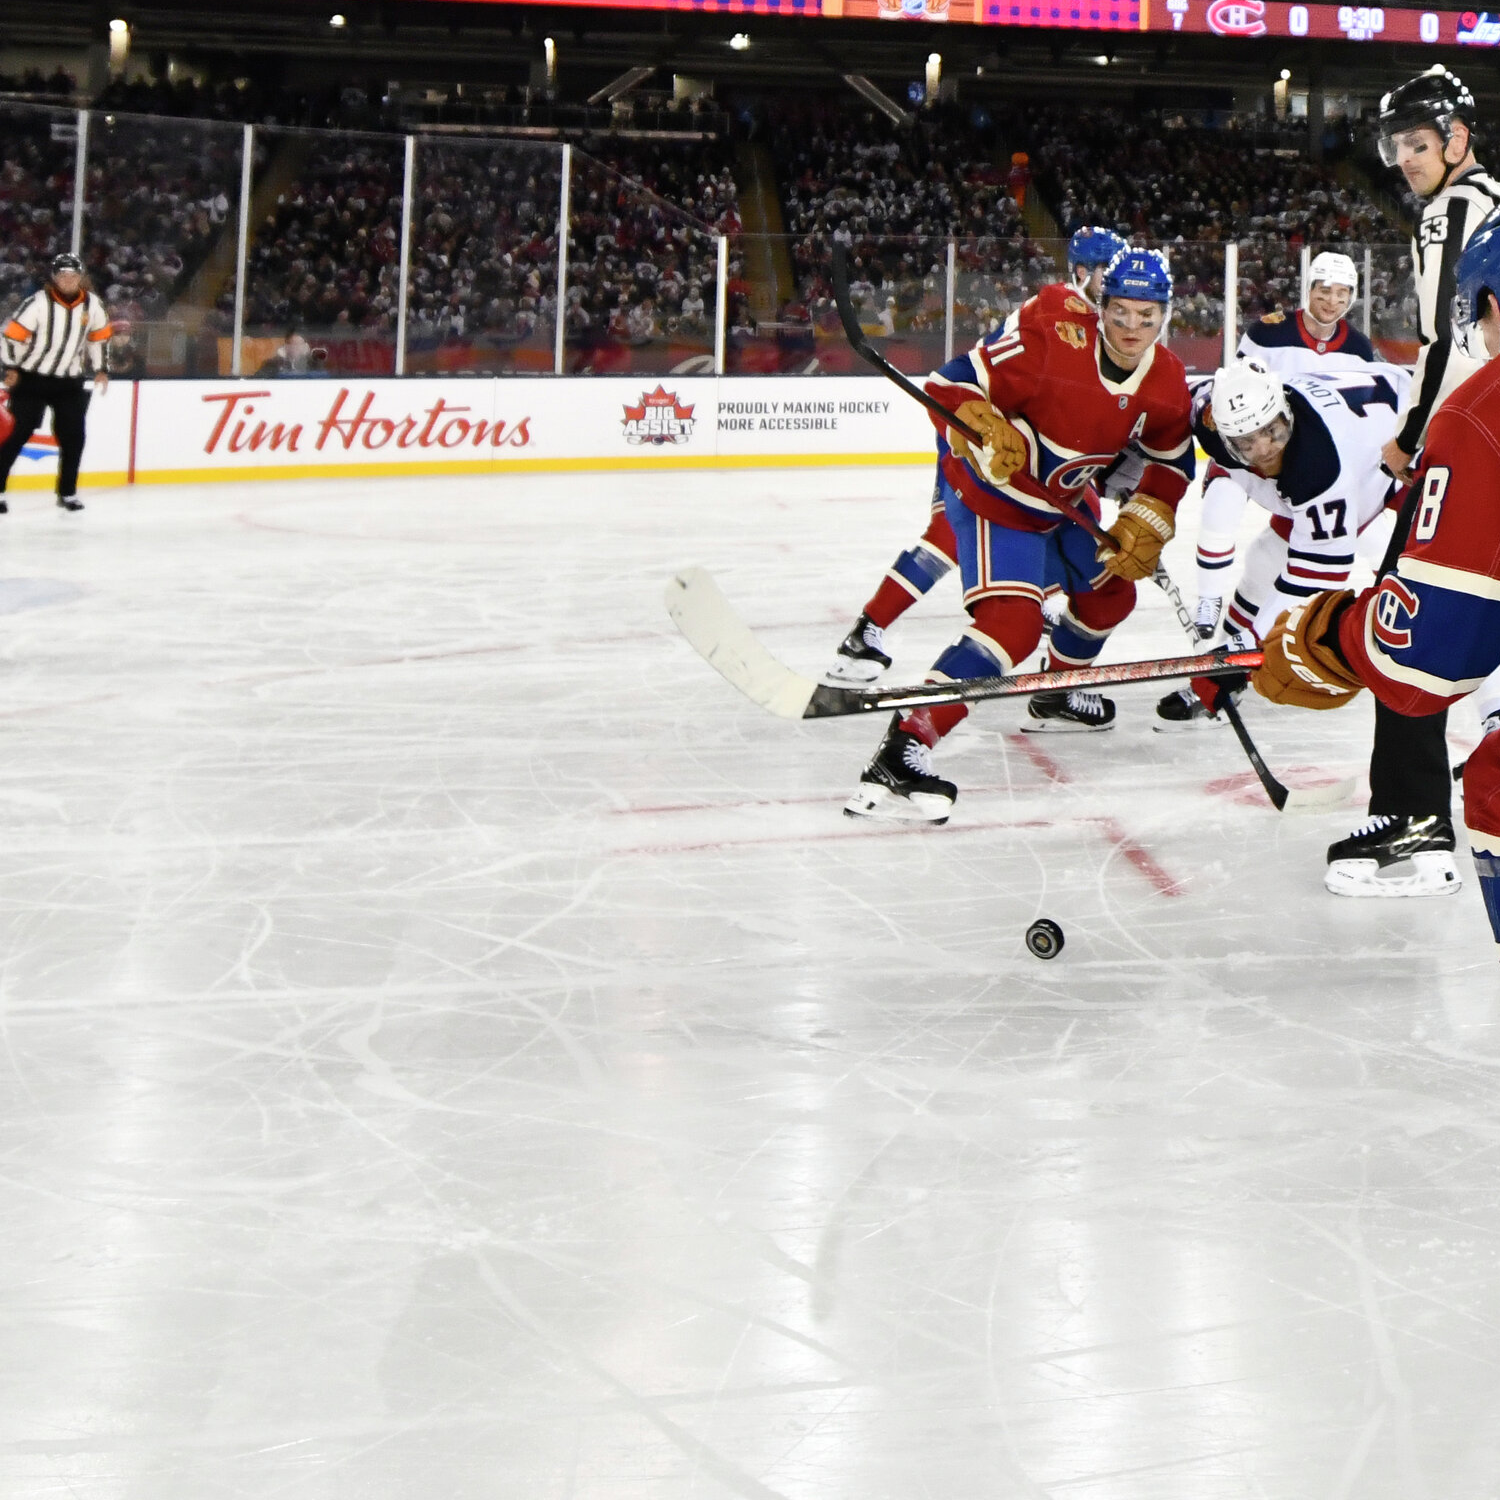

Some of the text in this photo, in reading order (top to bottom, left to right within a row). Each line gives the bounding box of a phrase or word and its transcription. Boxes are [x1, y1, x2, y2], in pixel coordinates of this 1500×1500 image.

[1171, 12, 1184, 31] 7
[1288, 5, 1309, 37] 0
[1337, 6, 1385, 33] 9:30
[1419, 12, 1440, 44] 0
[1420, 216, 1450, 248] 53
[1131, 260, 1145, 270] 71
[1123, 278, 1150, 288] CCM
[717, 401, 890, 414] PROUDLY MAKING HOCKEY
[1227, 393, 1246, 412] 17
[202, 387, 532, 455] Tim Hortons
[646, 406, 675, 421] BIG
[1234, 412, 1256, 425] CCM
[622, 419, 695, 436] ASSIST
[717, 418, 838, 431] MORE ACCESSIBLE
[1128, 411, 1149, 439] A
[1305, 497, 1348, 541] 17
[1336, 870, 1355, 880] CCM
